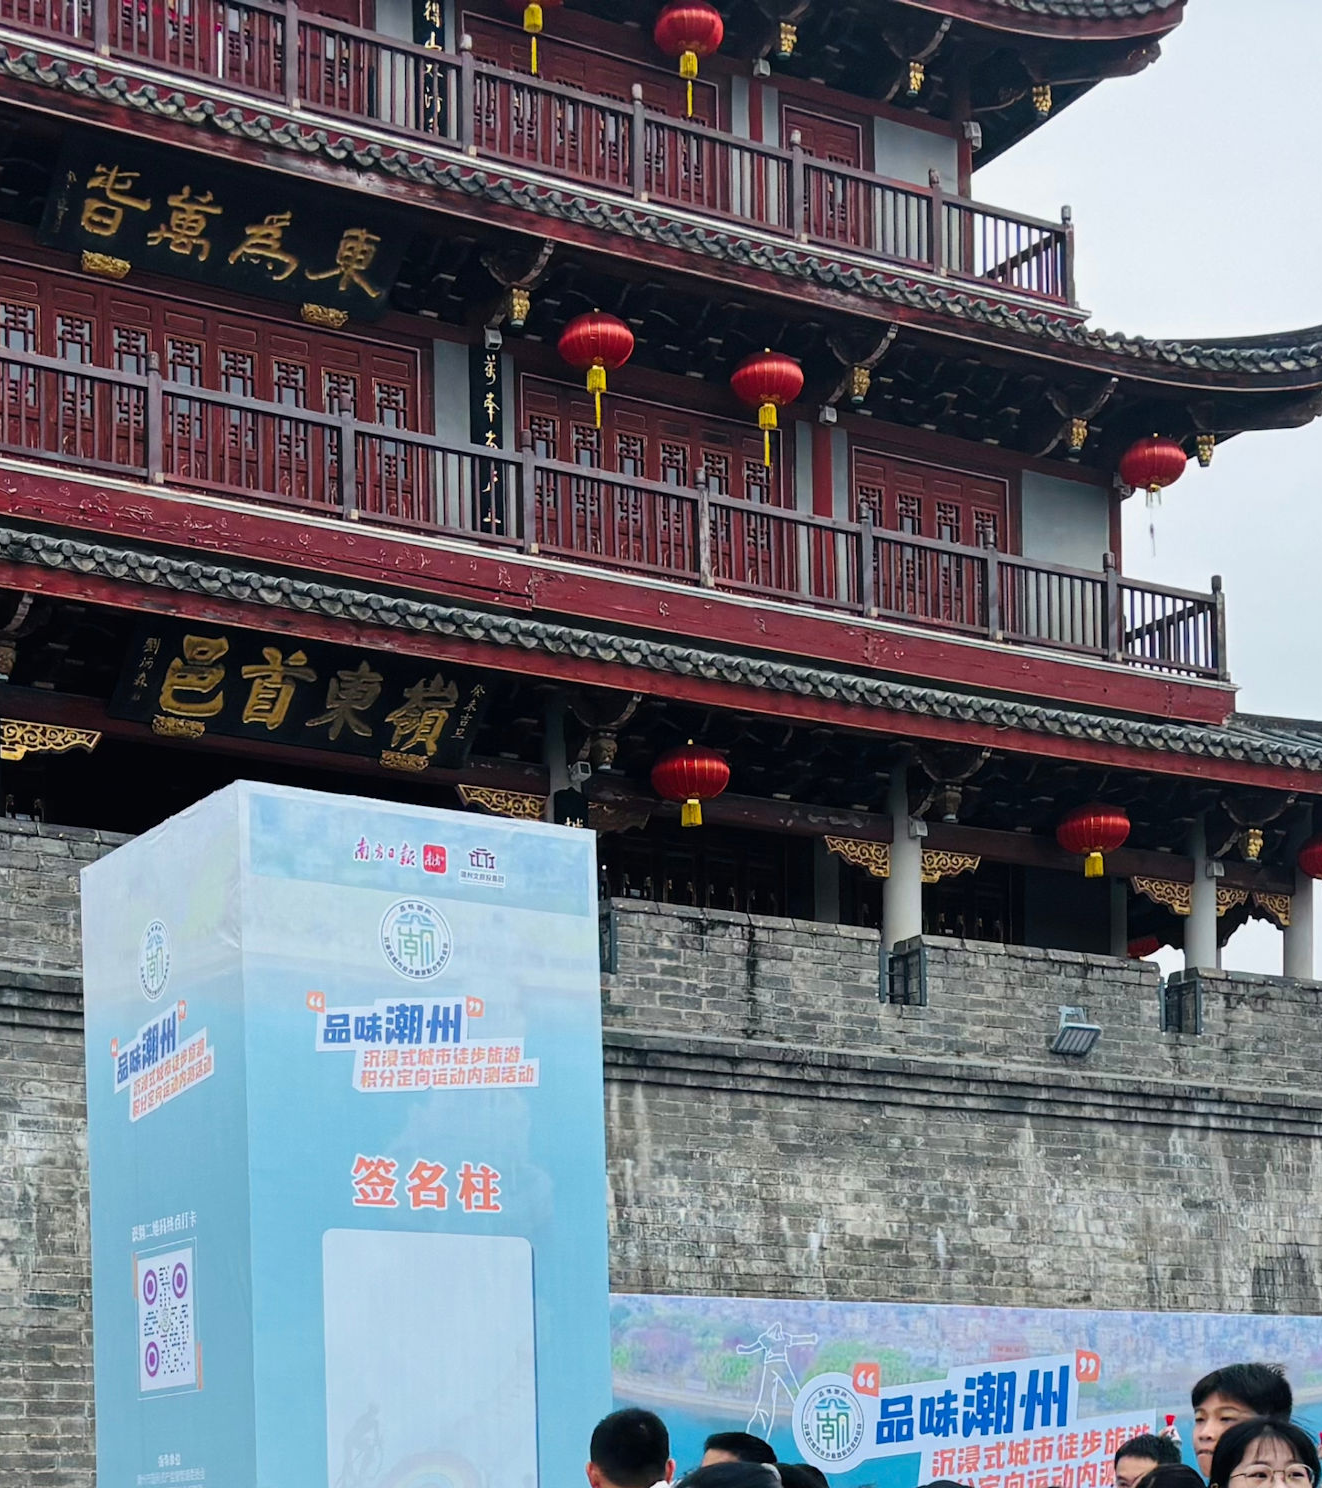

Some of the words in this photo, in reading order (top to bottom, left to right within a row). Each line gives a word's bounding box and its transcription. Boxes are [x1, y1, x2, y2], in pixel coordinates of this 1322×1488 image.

[364, 1047, 521, 1067] 沉浸式城市徒步旅游
[360, 1066, 534, 1088] 积分定向运动内测活动
[352, 1157, 500, 1211] 签名柱
